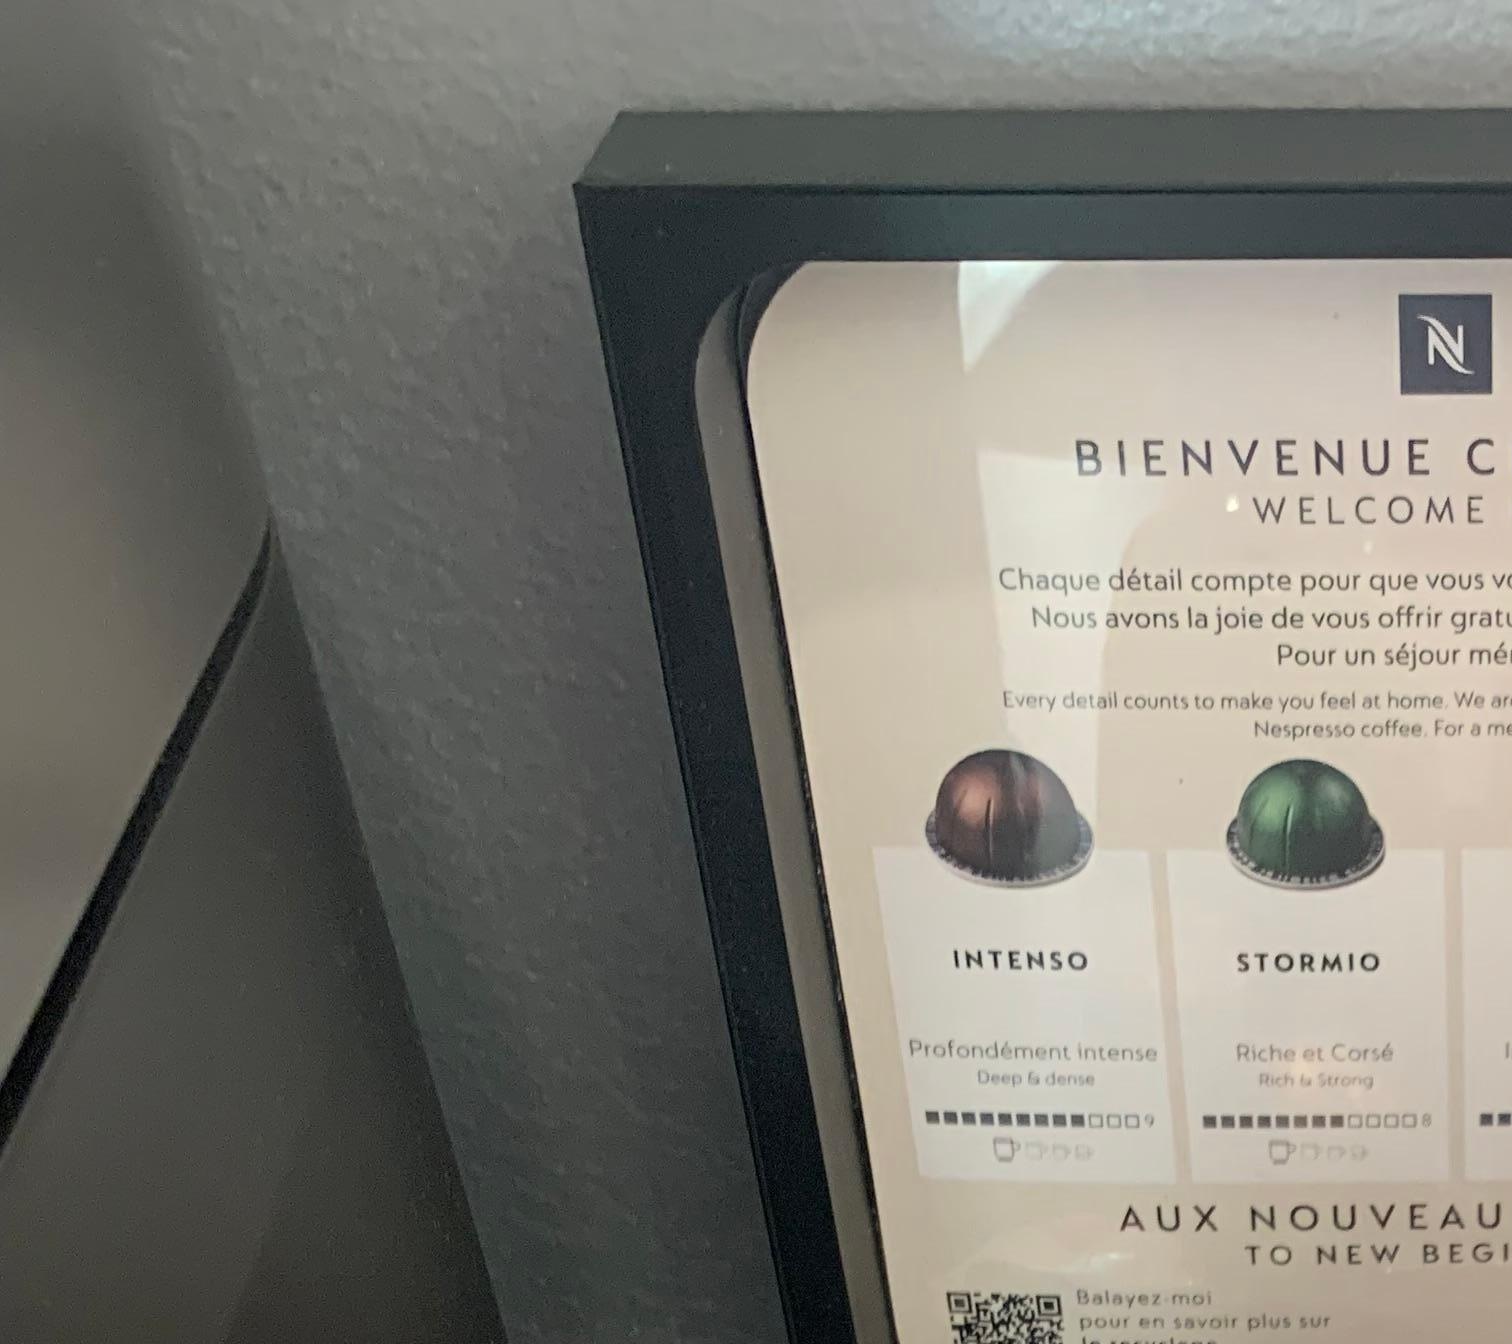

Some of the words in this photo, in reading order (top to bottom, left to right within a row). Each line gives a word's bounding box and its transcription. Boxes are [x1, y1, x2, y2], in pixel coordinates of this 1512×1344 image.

[1076, 439, 1429, 477] BIENVENUE
[1253, 495, 1483, 525] WELCOME
[999, 568, 1100, 596] Chaque
[1109, 567, 1182, 592] détail
[1191, 572, 1291, 598] compte
[1301, 574, 1360, 597] pour
[1370, 574, 1418, 597] que
[1426, 574, 1484, 591] vous
[1032, 606, 1097, 629] Nous
[1106, 612, 1179, 629] avons
[1188, 605, 1208, 629] la
[1215, 606, 1263, 636] joie
[1272, 605, 1304, 630] de
[1312, 612, 1370, 629] vous
[1378, 605, 1442, 629] offrir
[1278, 644, 1336, 667] Pour
[1345, 649, 1375, 666] un
[1385, 642, 1460, 672] séjour
[1003, 690, 1056, 712] Every
[1063, 691, 1117, 710] detail
[1124, 695, 1189, 711] counts
[1194, 695, 1214, 710] to
[1221, 691, 1273, 710] make
[1279, 696, 1314, 714] you
[1321, 690, 1355, 710] feel
[1362, 694, 1380, 710] at
[1388, 691, 1448, 711] home.
[1454, 690, 1485, 709] We
[1254, 720, 1355, 742] Nespresso
[1361, 718, 1427, 737] coffee.
[1435, 718, 1464, 737] For
[1471, 723, 1481, 737] a
[954, 949, 1087, 971] INTENSO
[1237, 952, 1379, 973] STORMIO
[909, 1038, 1071, 1061] Profondément
[1078, 1043, 1157, 1062] intense
[1236, 1043, 1296, 1063] Riche
[1303, 1047, 1324, 1062] et
[1331, 1042, 1393, 1062] Corsé
[978, 1069, 1022, 1089] Deep
[1045, 1071, 1095, 1087] dense
[1259, 1071, 1294, 1088] Rich
[1318, 1072, 1374, 1091] Strong
[1120, 1204, 1217, 1232] AUX
[1245, 1244, 1292, 1266] TO
[1316, 1244, 1400, 1265] NEW
[1077, 1288, 1211, 1307] Balayez-moi
[1079, 1315, 1129, 1332] pour
[1139, 1316, 1164, 1329] en
[1174, 1315, 1238, 1330] savoir
[1247, 1312, 1291, 1332] plus
[1299, 1316, 1330, 1328] sur
